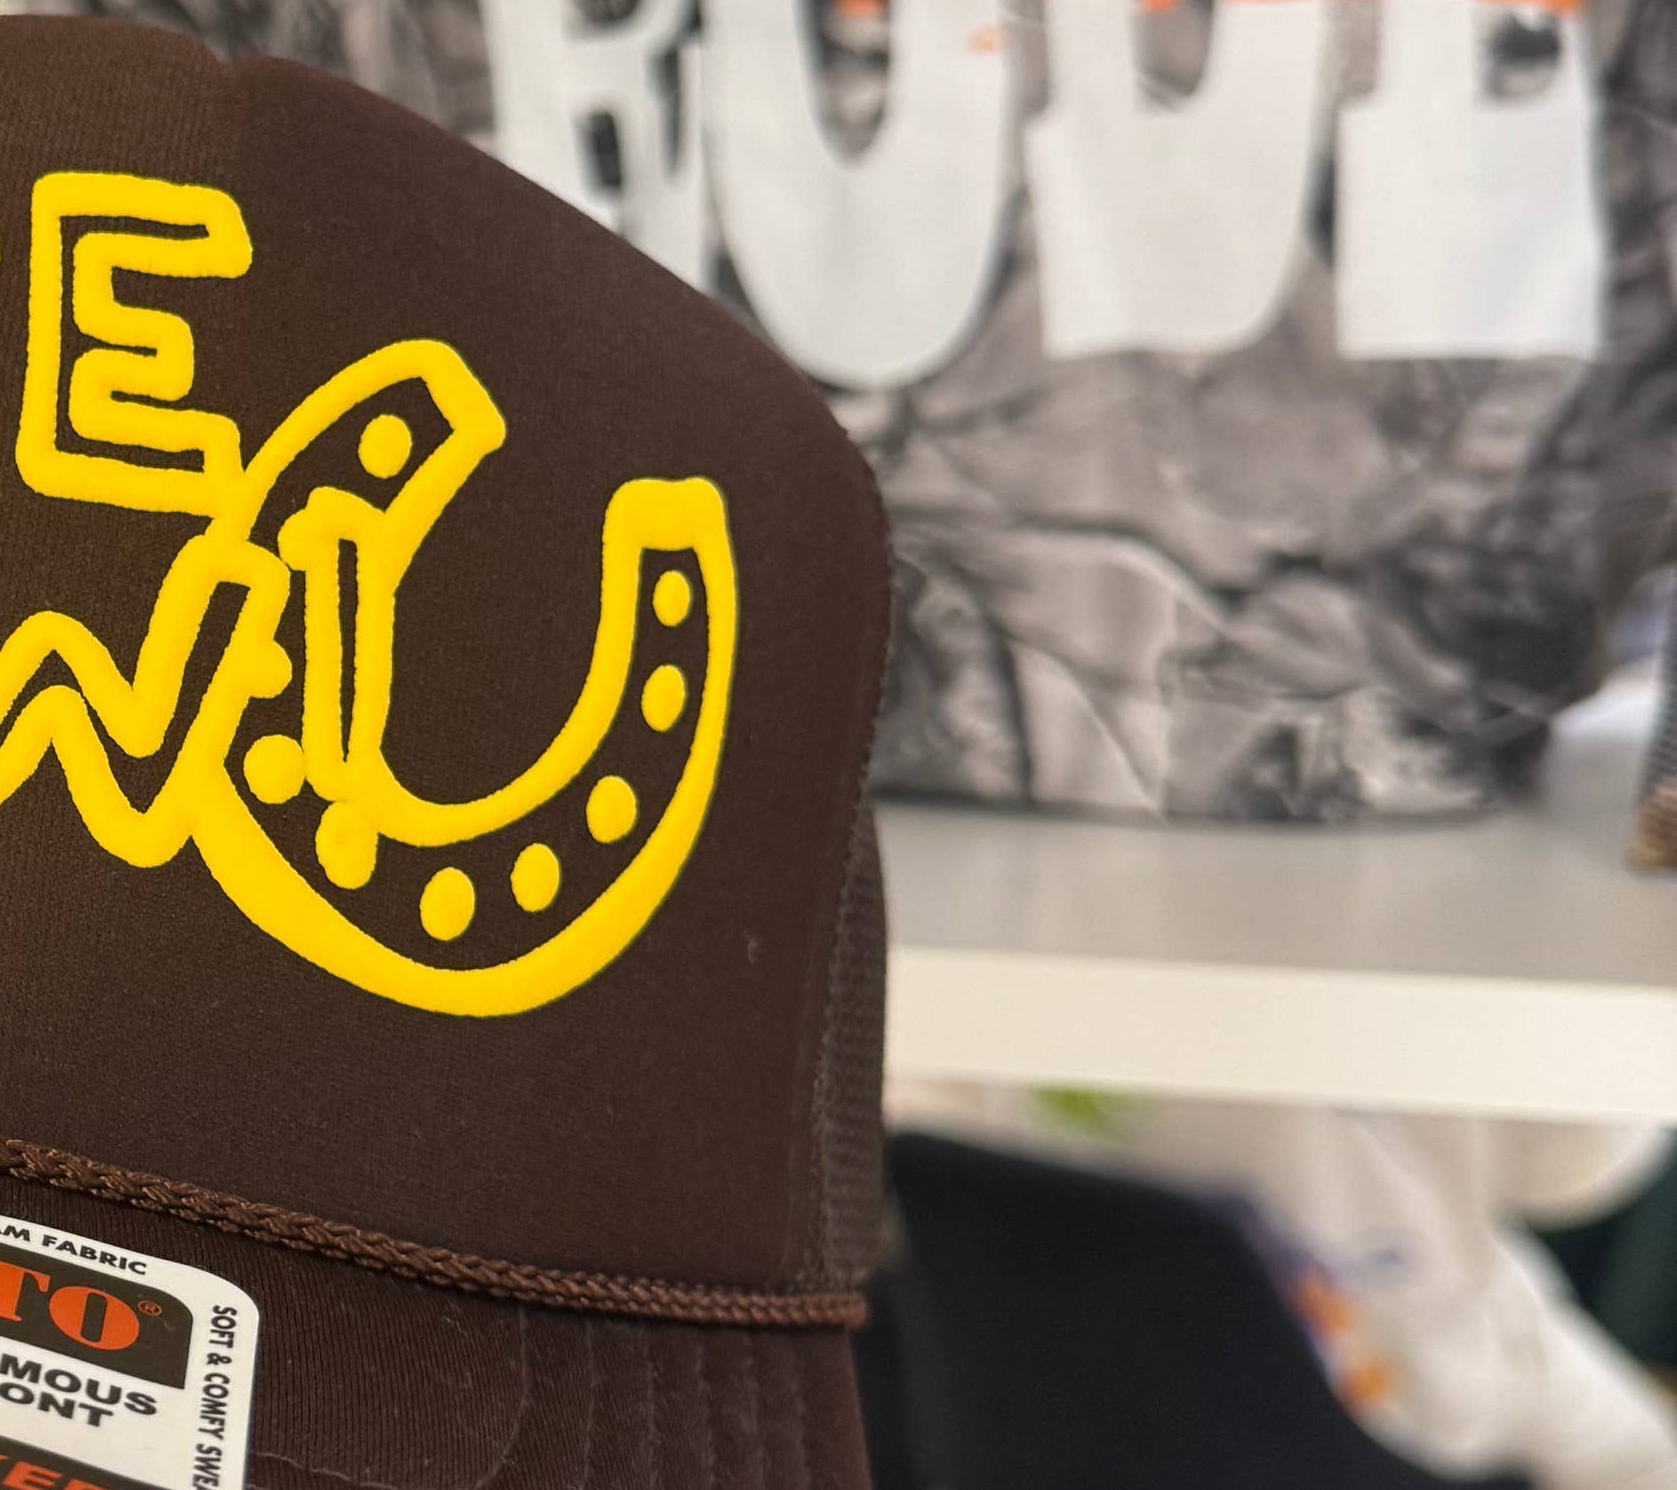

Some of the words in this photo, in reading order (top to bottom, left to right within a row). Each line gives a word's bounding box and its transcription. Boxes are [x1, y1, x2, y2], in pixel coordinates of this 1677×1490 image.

[41, 1233, 148, 1277] FABRIC
[207, 1304, 238, 1349] SOFT
[206, 1351, 233, 1366] &
[197, 1371, 231, 1441] COMFY
